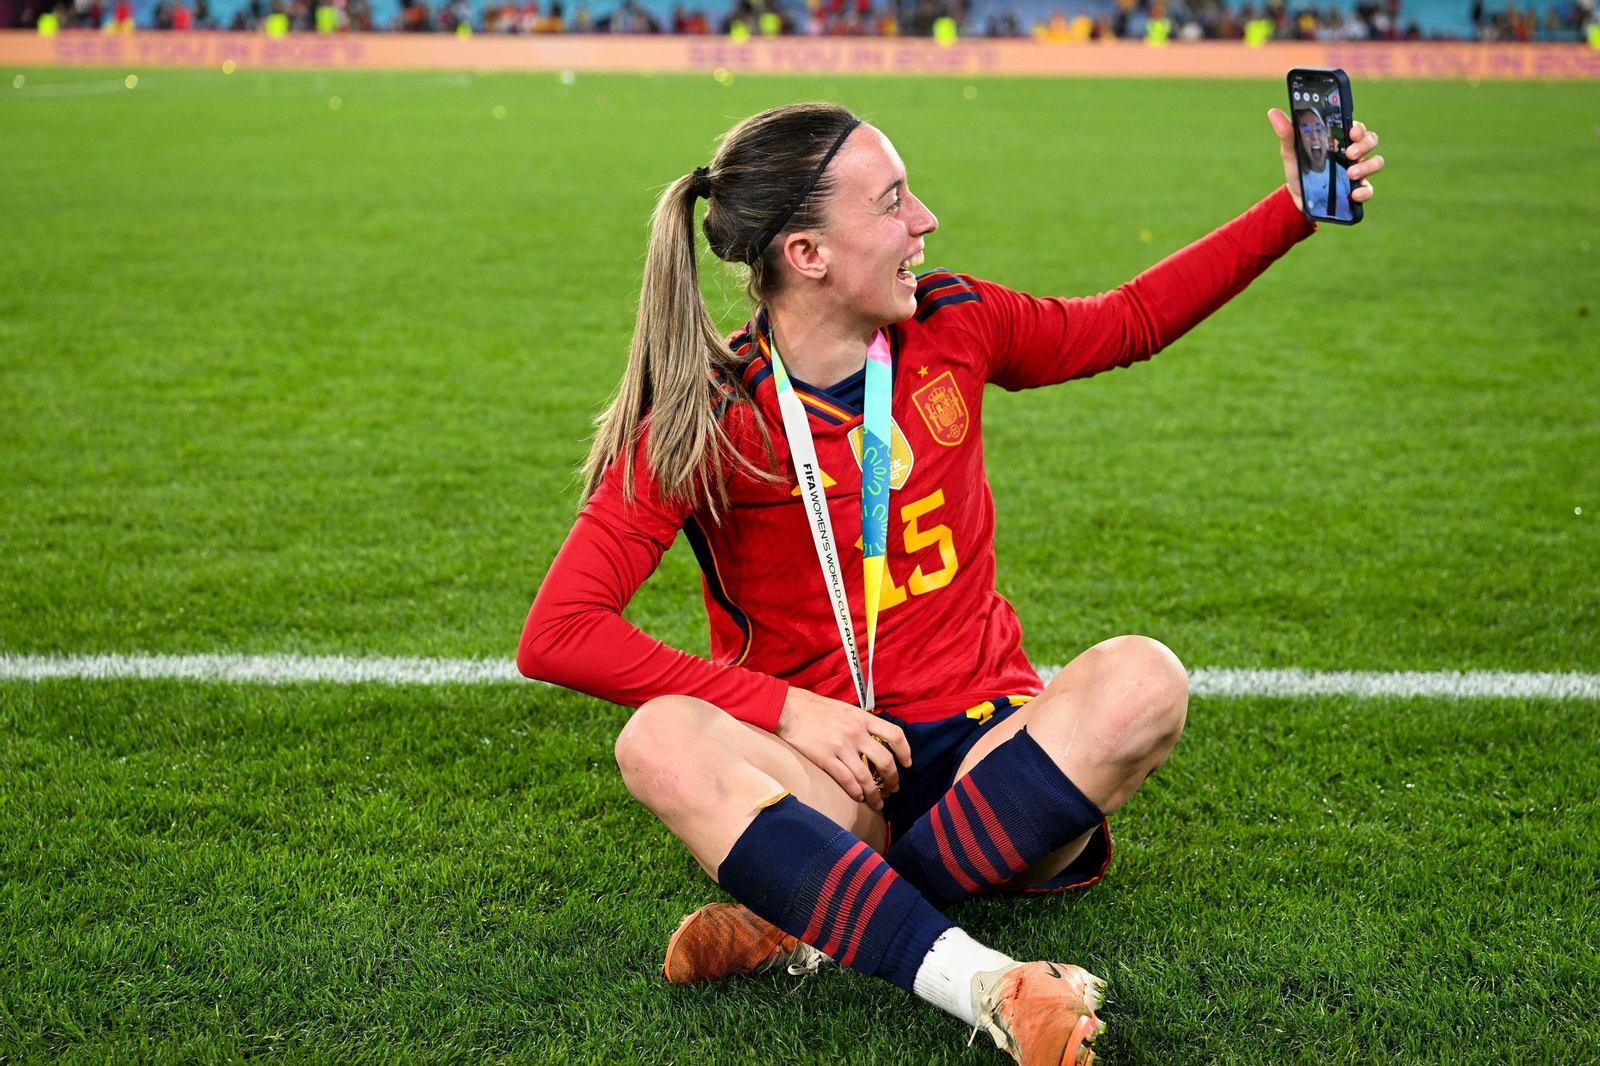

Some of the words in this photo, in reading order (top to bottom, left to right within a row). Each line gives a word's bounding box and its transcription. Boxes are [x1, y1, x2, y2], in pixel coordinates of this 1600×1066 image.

[57, 39, 121, 60] SEE
[141, 39, 207, 61] YOU
[216, 40, 250, 61] IN
[691, 44, 755, 65] SEE
[771, 44, 839, 66] YOU
[852, 45, 882, 66] IN
[1326, 49, 1391, 72] SEE
[1409, 49, 1480, 73] YOU
[1490, 50, 1521, 73] IN
[803, 463, 816, 491] FIFA
[810, 490, 831, 552] WOMEN'S
[826, 553, 842, 599] WORLD
[838, 599, 849, 626] CUP
[854, 488, 959, 612] 15
